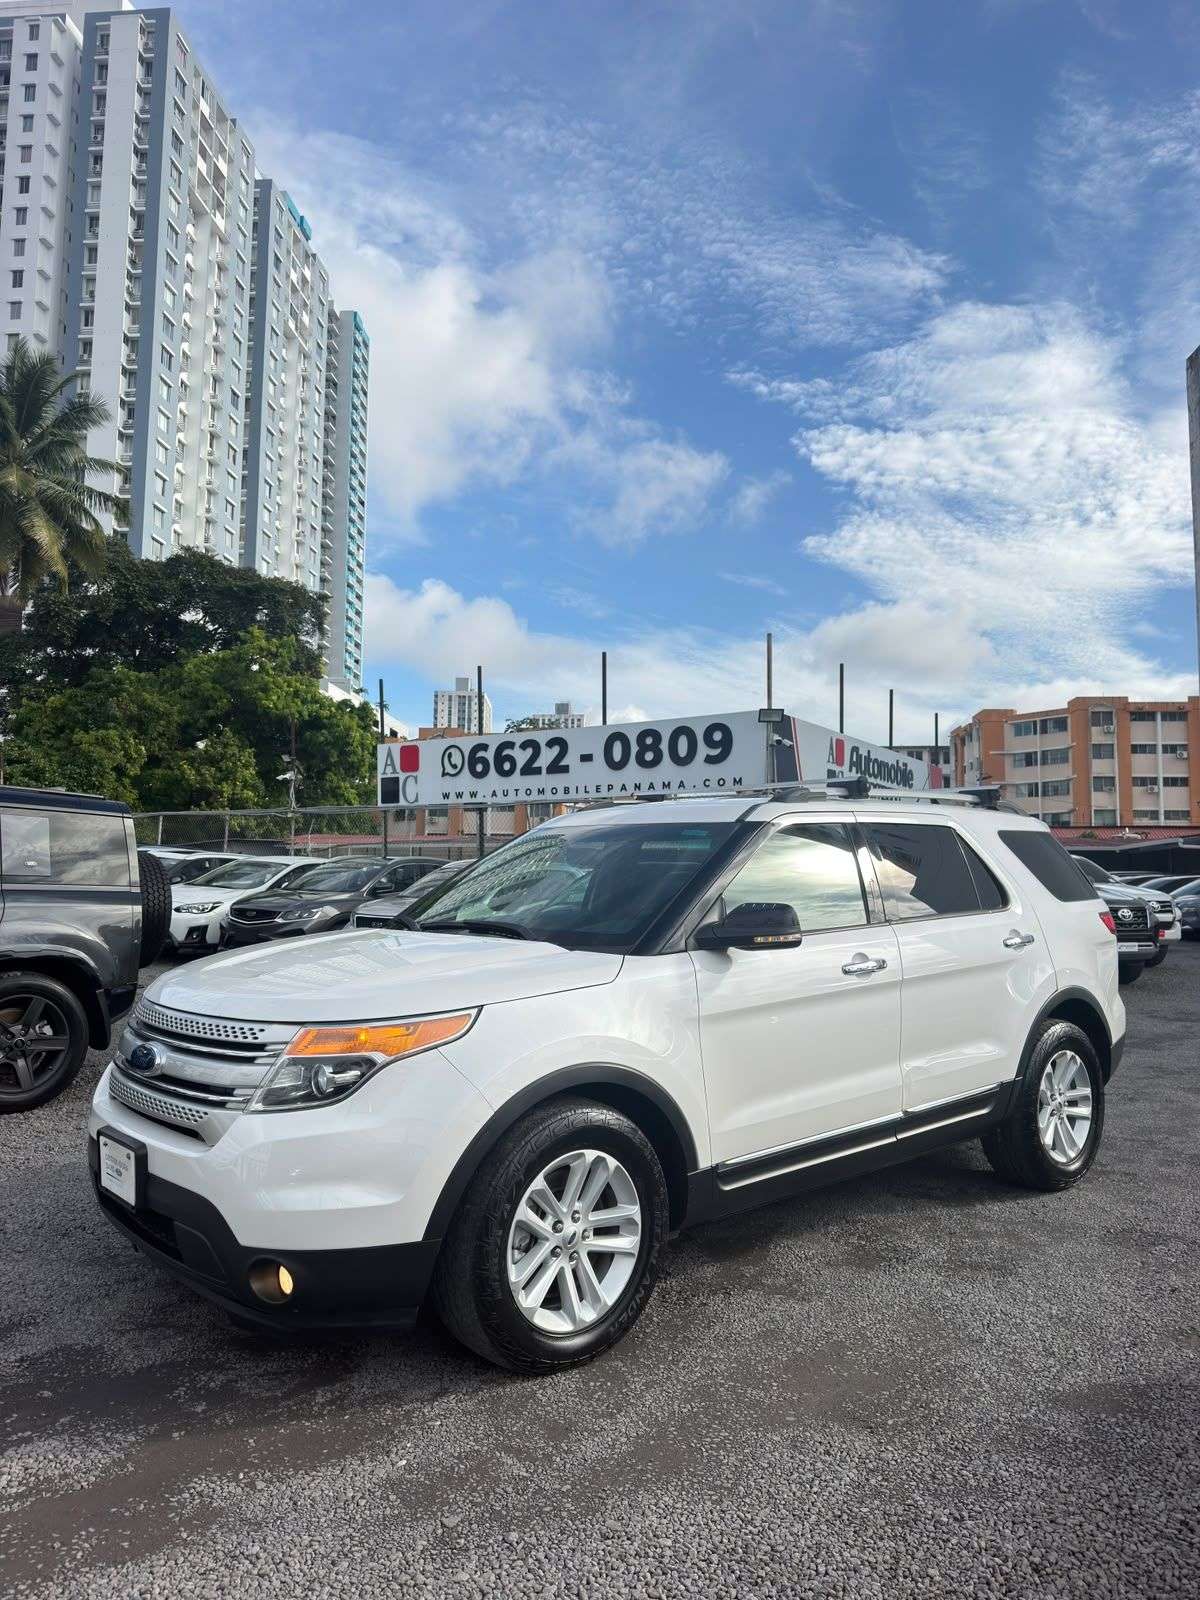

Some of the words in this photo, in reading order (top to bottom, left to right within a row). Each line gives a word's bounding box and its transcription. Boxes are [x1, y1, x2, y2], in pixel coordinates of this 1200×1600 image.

[382, 745, 399, 776] A
[827, 736, 836, 764] A
[849, 745, 914, 789] Automobile
[401, 775, 420, 804] C
[441, 776, 744, 800] WWW.AUTOMOBILEPANAMA.COM
